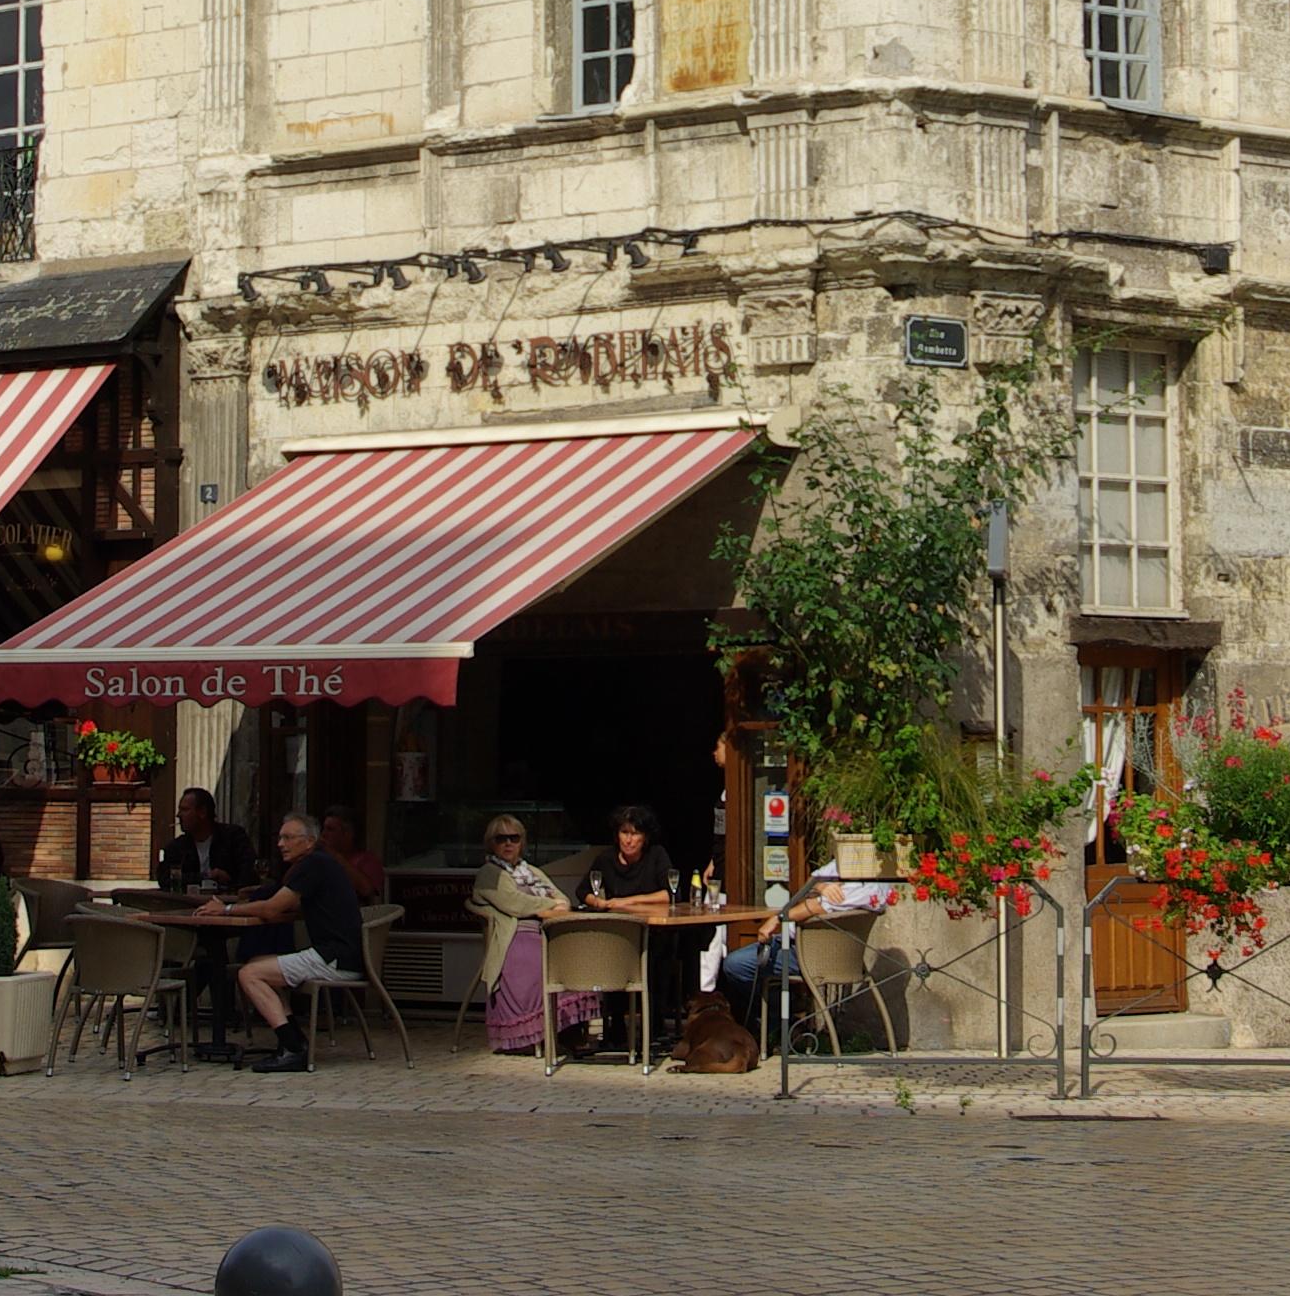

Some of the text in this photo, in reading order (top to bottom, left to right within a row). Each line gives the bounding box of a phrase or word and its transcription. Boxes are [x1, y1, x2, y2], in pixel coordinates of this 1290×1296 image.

[276, 322, 735, 407] MAISON DE RABELAIS
[205, 487, 214, 500] 2
[84, 663, 345, 698] Salon de Thé
